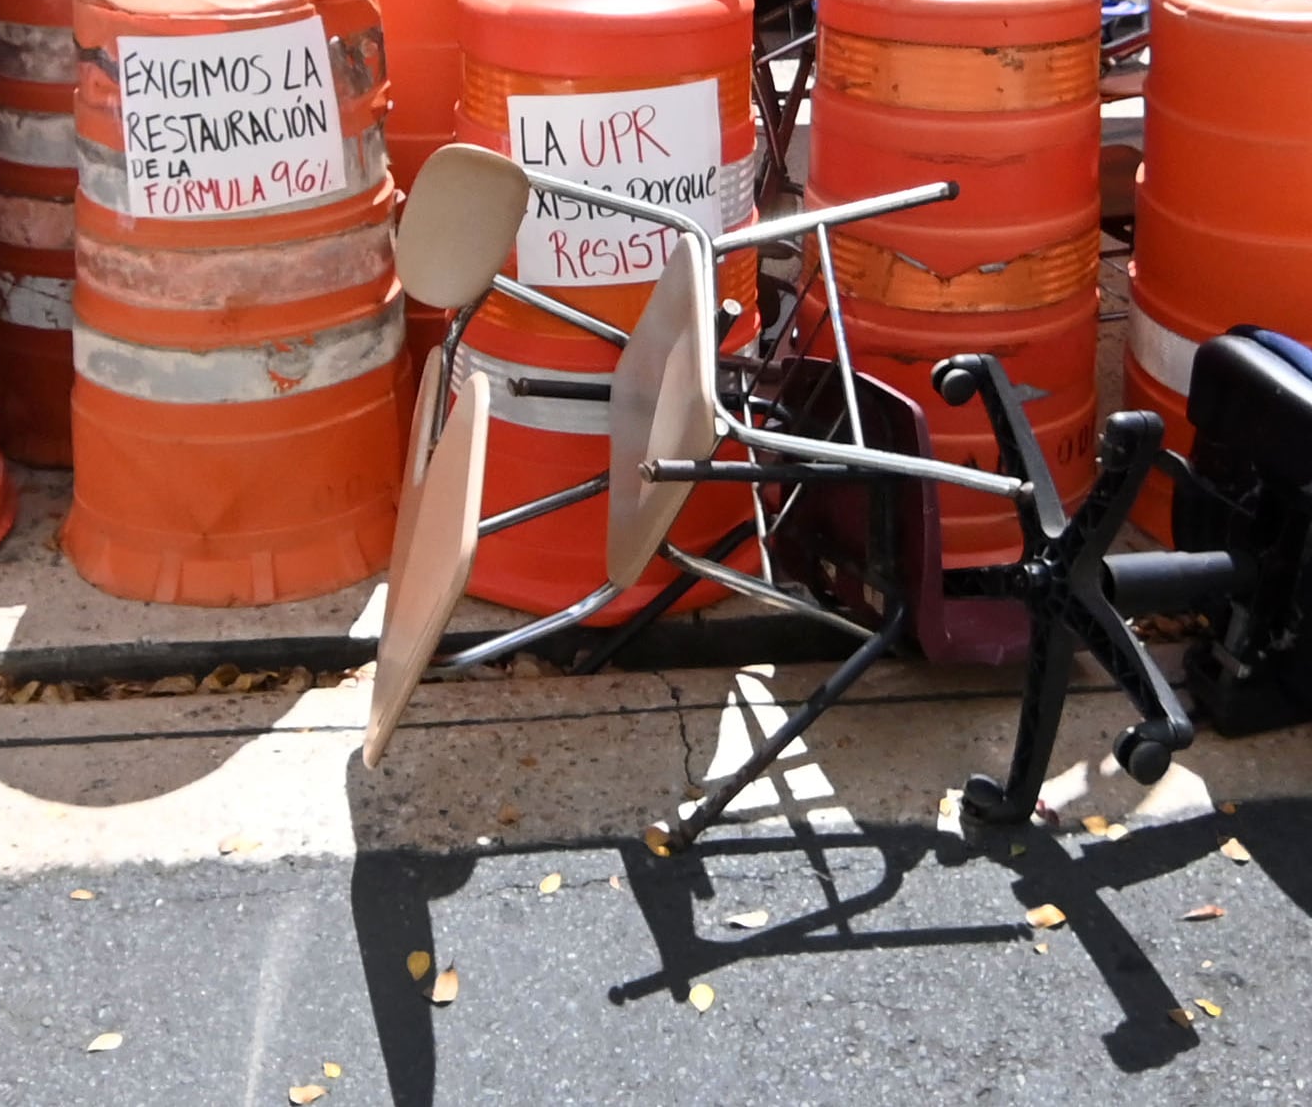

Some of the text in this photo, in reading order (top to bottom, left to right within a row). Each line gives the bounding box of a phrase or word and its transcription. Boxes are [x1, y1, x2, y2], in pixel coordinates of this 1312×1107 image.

[124, 46, 323, 99] EXIGIMOS LA
[126, 95, 328, 154] RESTAURACIÓN
[520, 104, 670, 167] LA UPR
[133, 158, 192, 180] DE LA
[143, 174, 266, 215] FÓRMULA
[626, 165, 717, 223] porque
